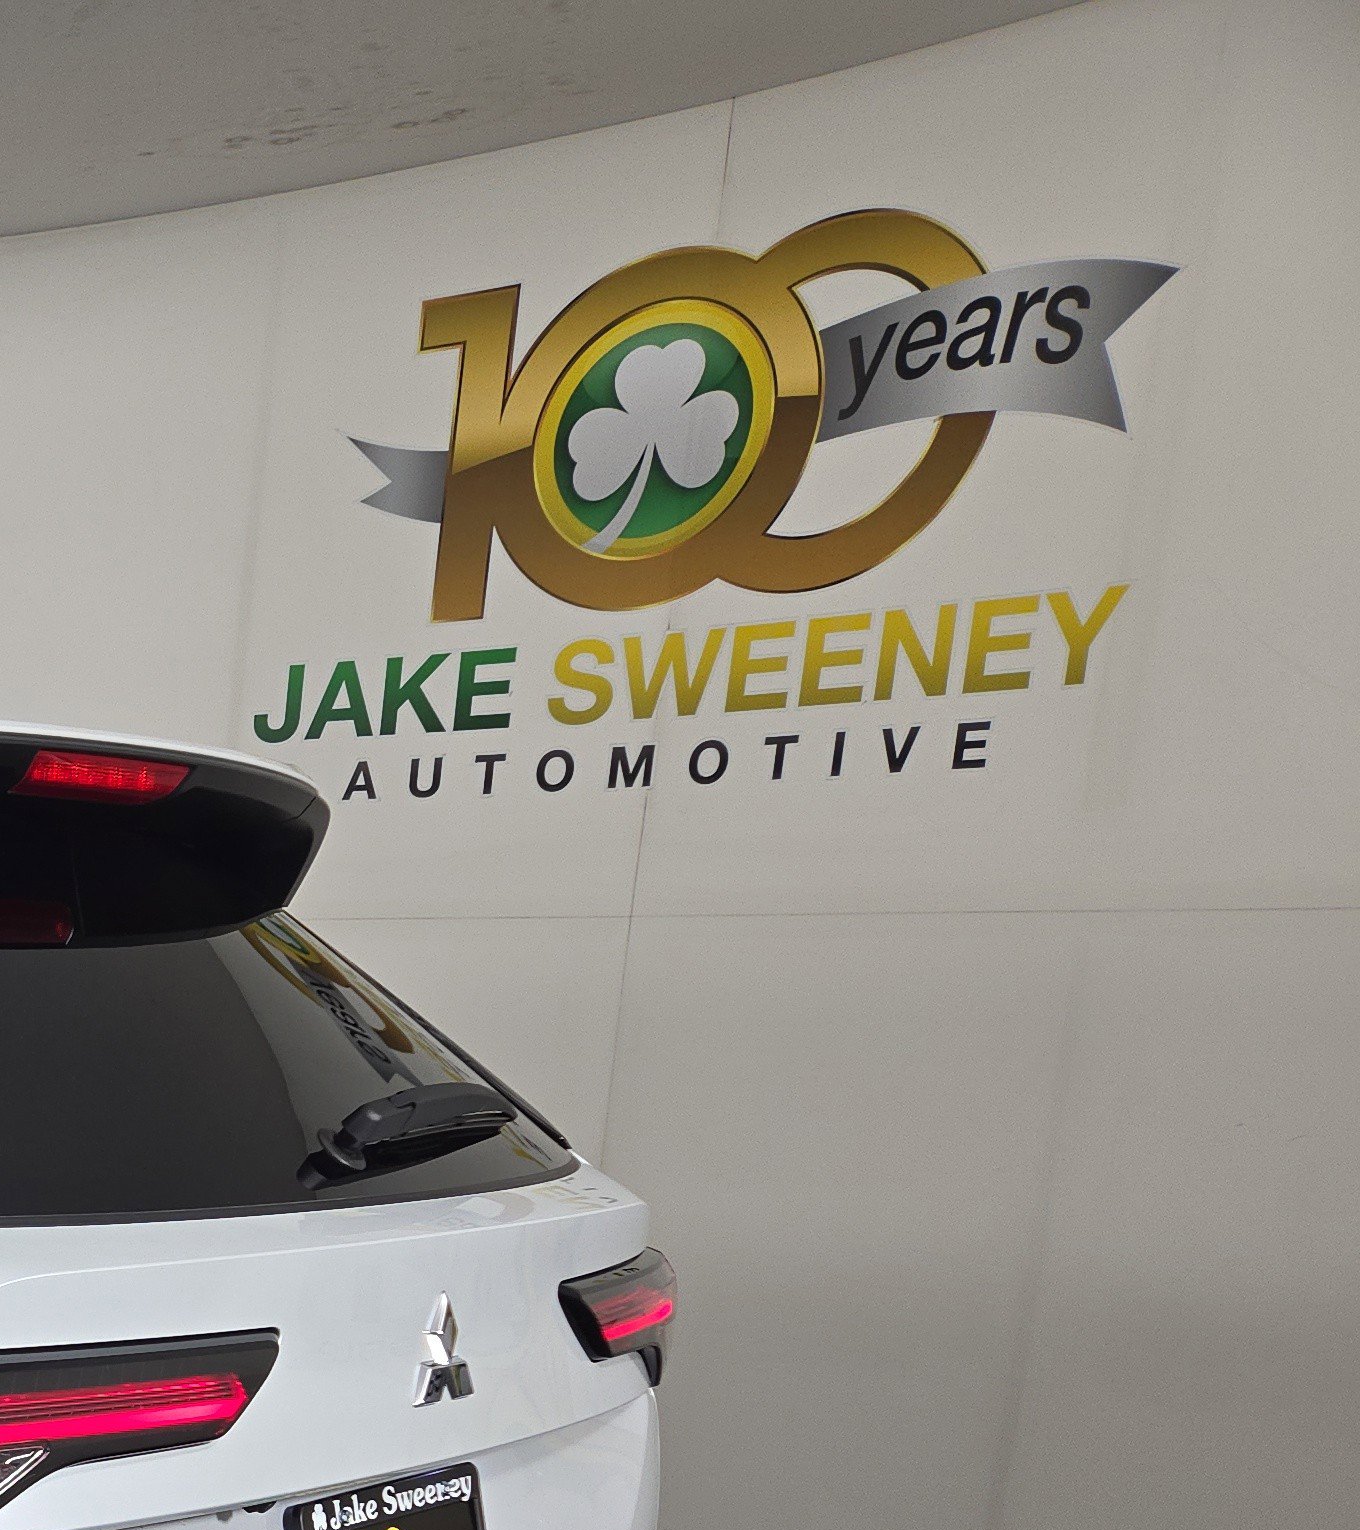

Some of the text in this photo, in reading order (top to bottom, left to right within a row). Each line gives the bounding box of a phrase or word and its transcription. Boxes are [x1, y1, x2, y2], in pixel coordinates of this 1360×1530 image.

[838, 282, 1090, 420] years
[253, 584, 1130, 744] JAKE SWEENEY
[342, 721, 993, 801] AUTOMOTIVE
[330, 1494, 379, 1530] Jake
